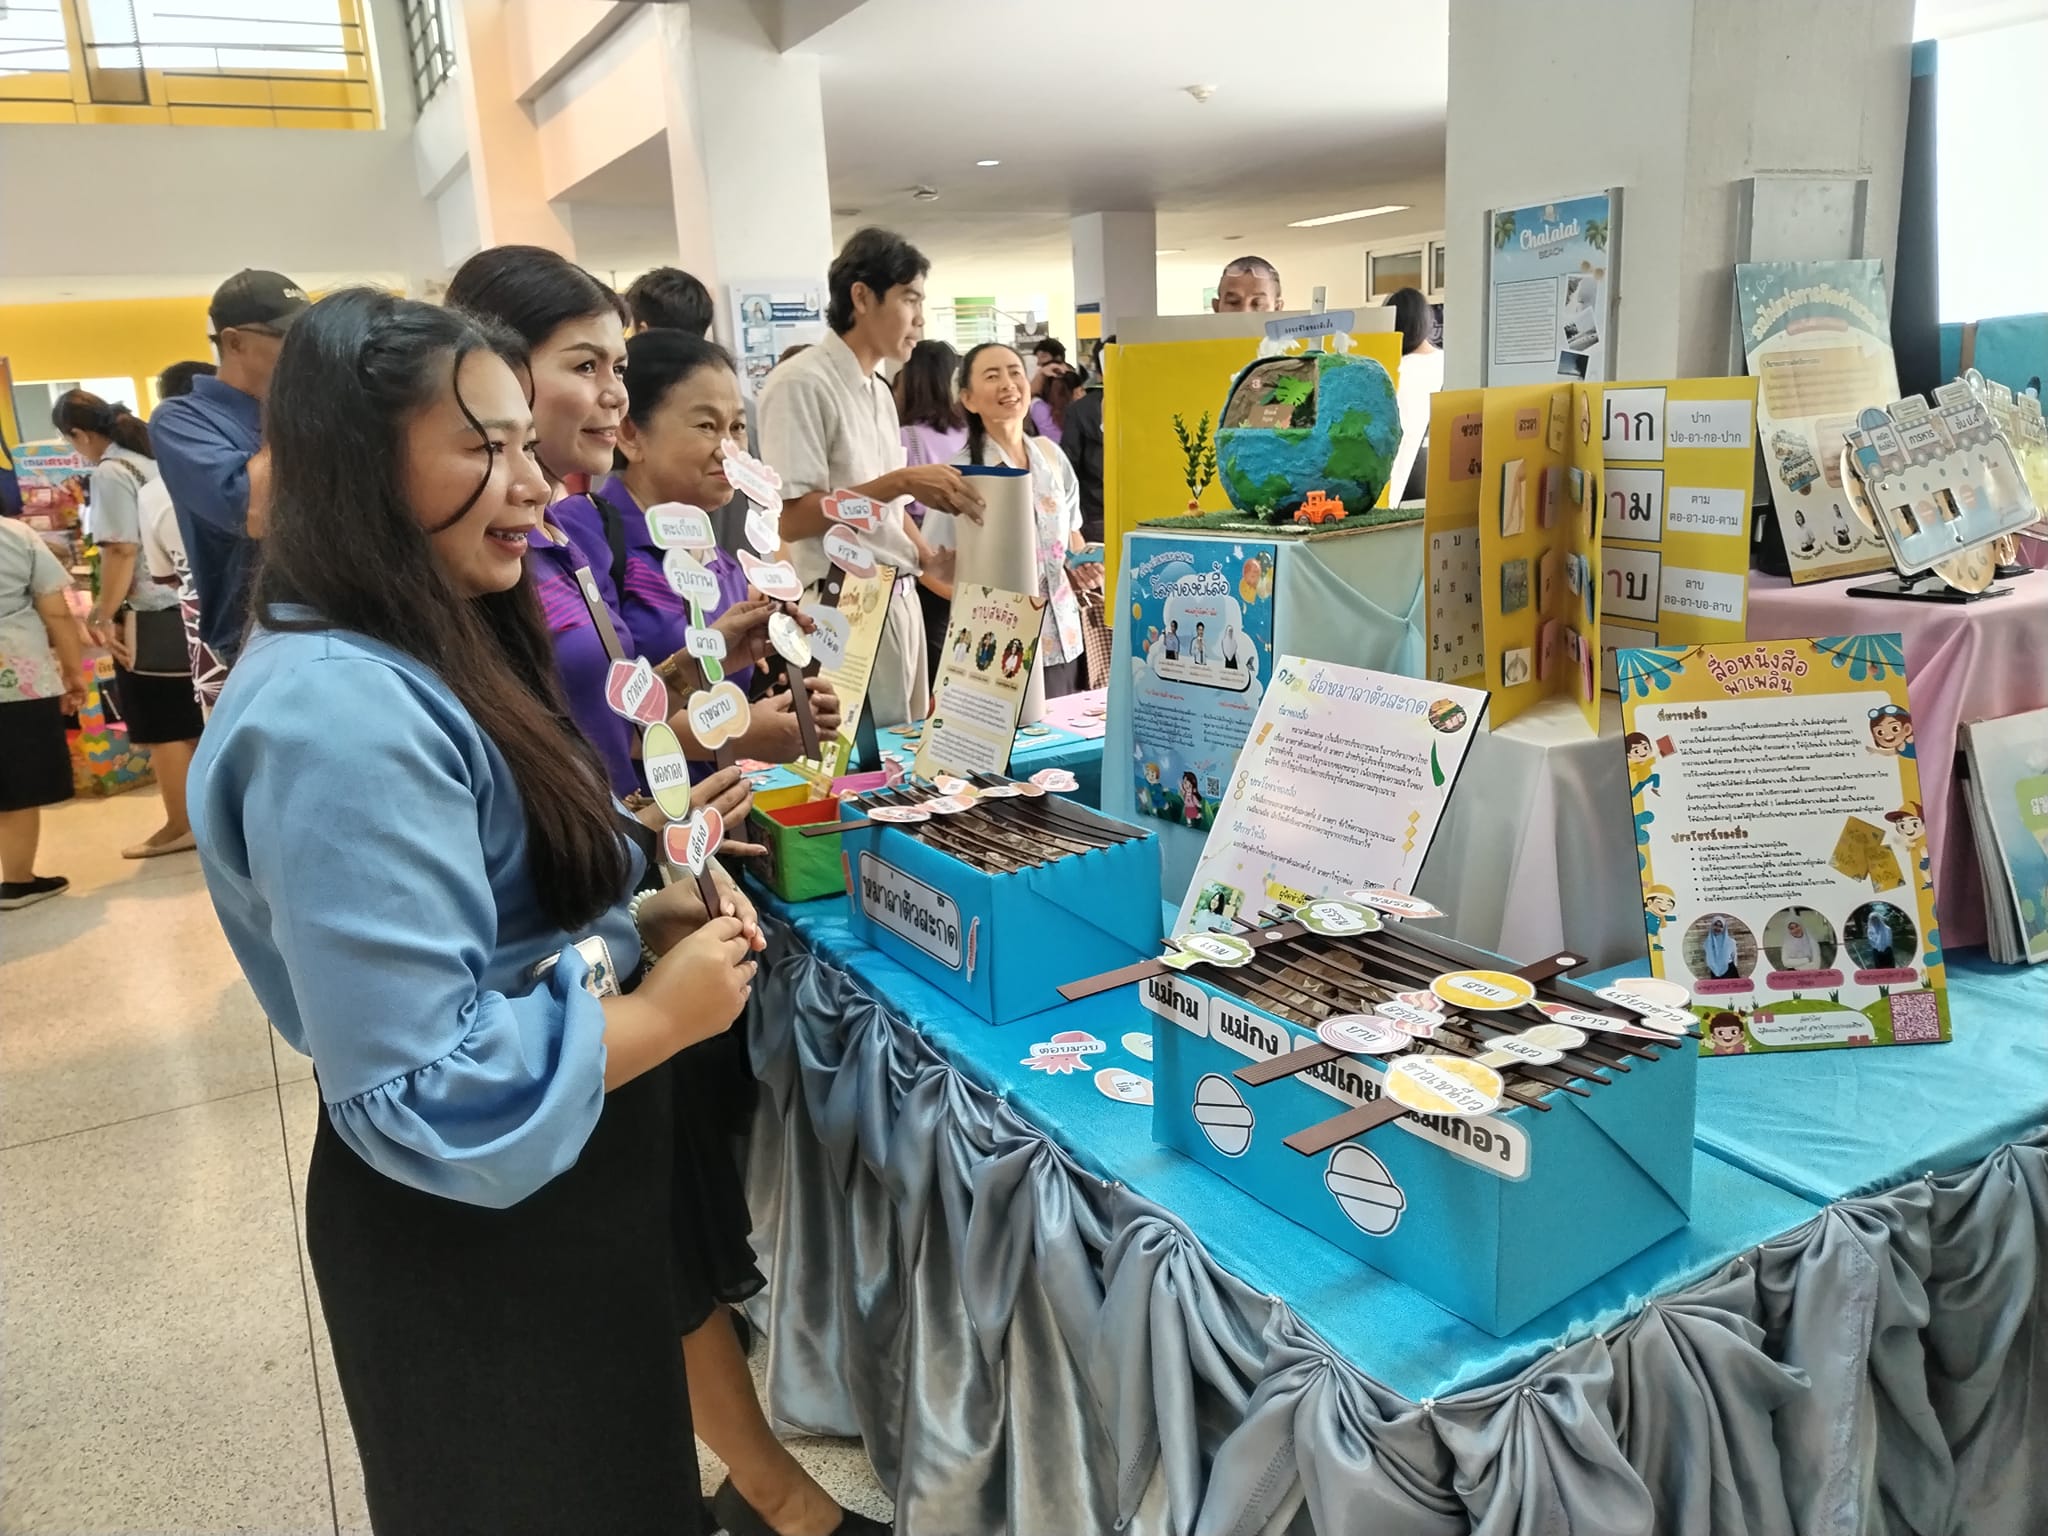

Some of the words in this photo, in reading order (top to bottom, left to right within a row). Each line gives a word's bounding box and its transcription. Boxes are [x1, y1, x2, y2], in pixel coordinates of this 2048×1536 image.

[1691, 412, 1711, 424] ปาก
[1670, 431, 1742, 443] ปอ-อา-กอ-ปาก
[1691, 494, 1711, 505] ตาม
[1669, 511, 1739, 526] ตอ-อา-มอ-ตาม
[1685, 578, 1705, 590] ลาบ
[1664, 594, 1733, 613] ลอ-อา-บอ-ลาบ
[1707, 647, 1808, 682] สื่อหนังสือ
[1724, 670, 1793, 695] พาเพลิน
[652, 763, 683, 785] ลองกอง
[1570, 1014, 1609, 1026] ดาว
[1220, 1010, 1279, 1056] แม่กง
